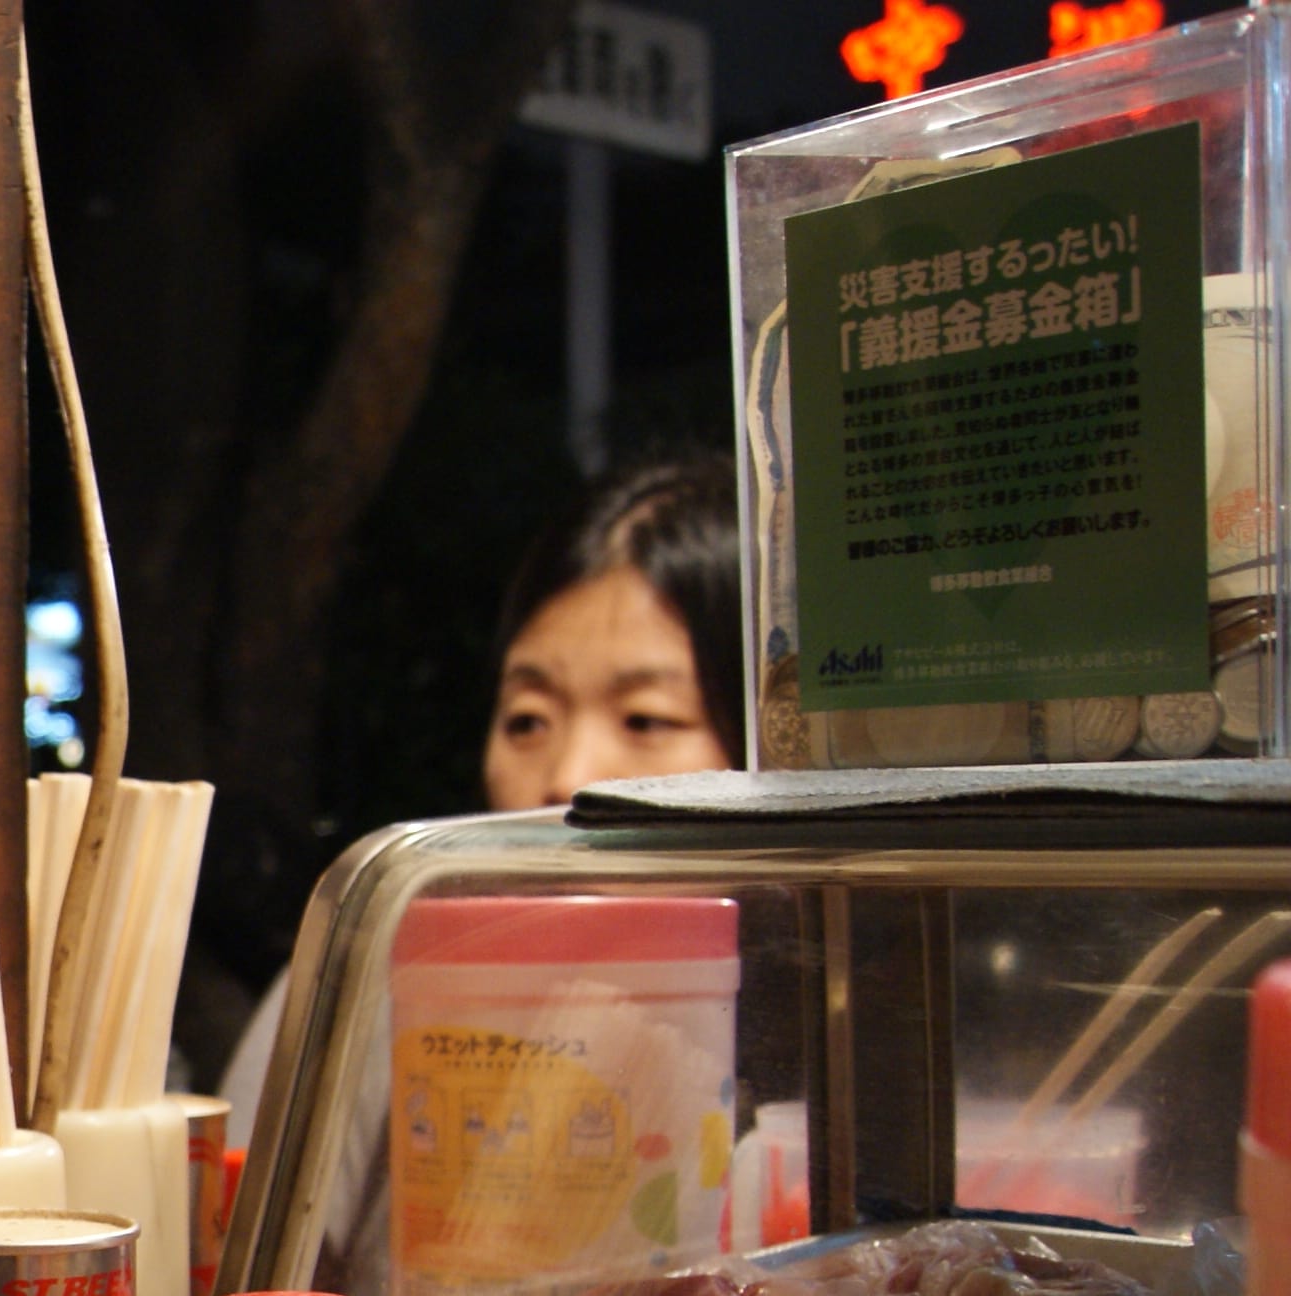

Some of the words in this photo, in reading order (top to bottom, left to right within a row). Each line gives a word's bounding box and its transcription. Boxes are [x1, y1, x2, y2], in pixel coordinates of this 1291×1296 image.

[841, 266, 1141, 372] 「義援金募金箱」
[819, 644, 883, 676] Asahi
